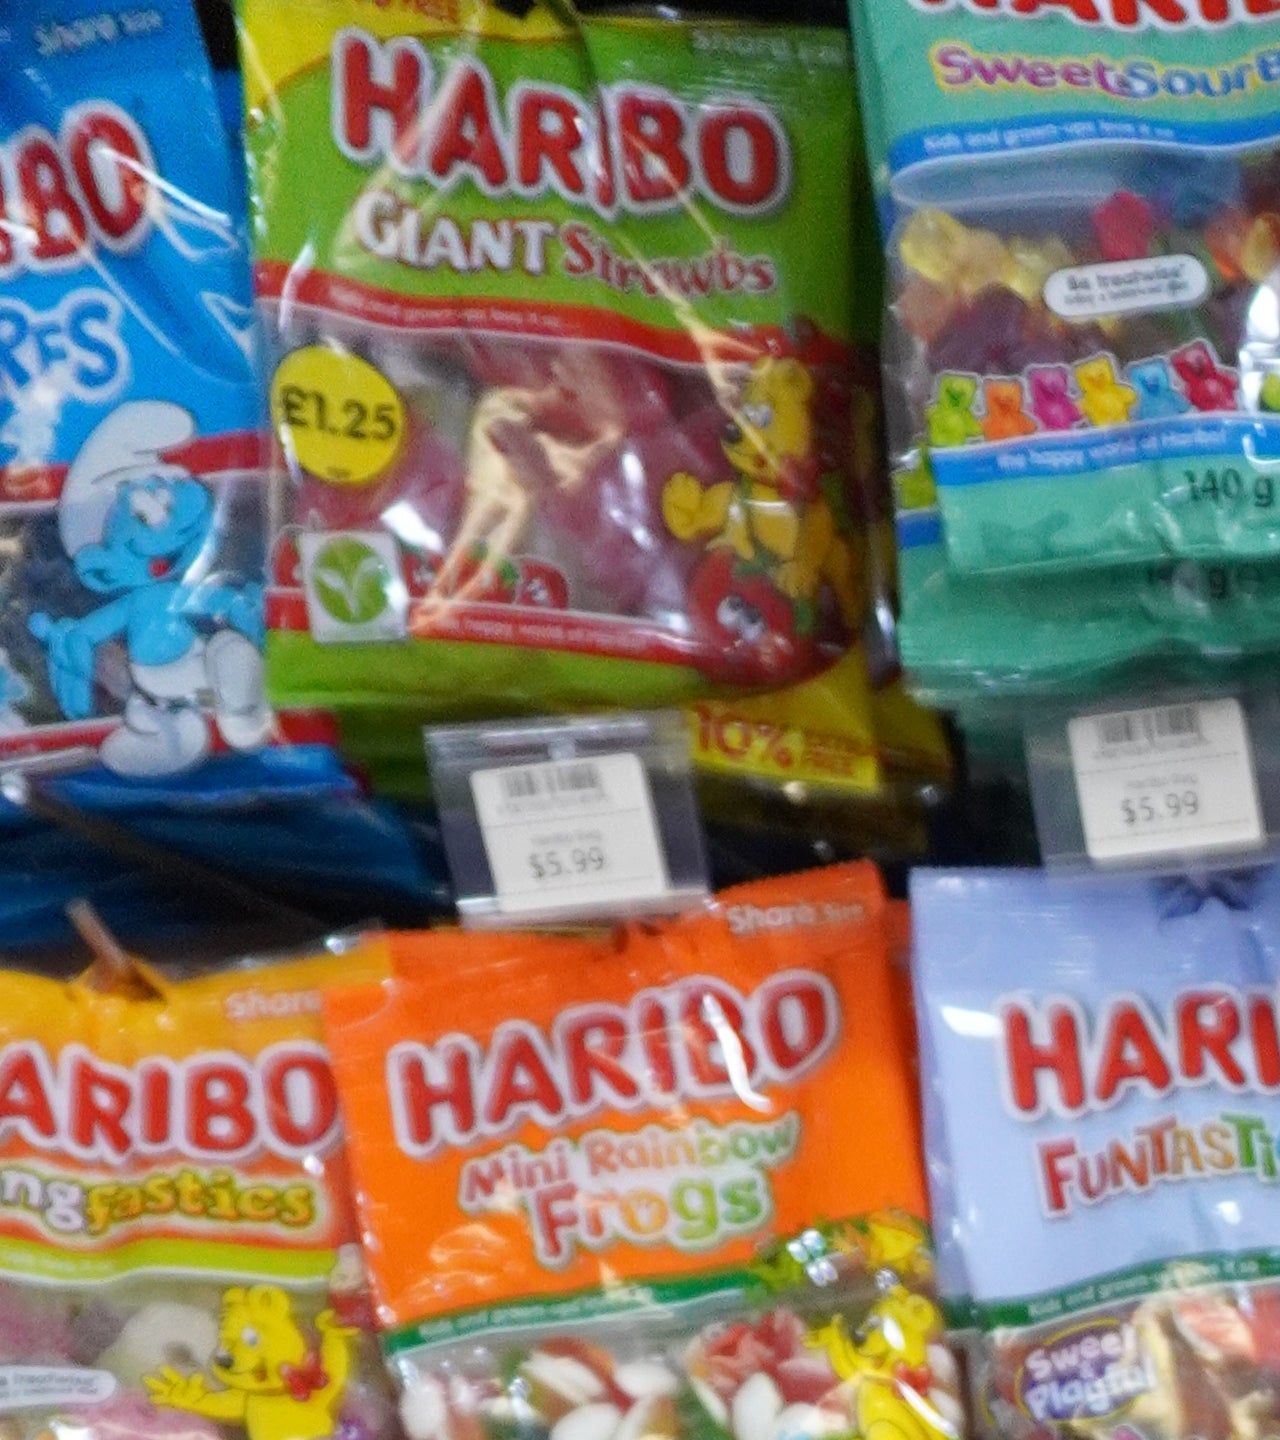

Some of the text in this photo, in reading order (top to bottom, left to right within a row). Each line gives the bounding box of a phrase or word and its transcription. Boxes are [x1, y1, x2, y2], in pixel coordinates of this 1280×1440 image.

[335, 28, 790, 218] HARIBO
[357, 188, 556, 276] GIANT
[280, 385, 396, 445] £1.25
[697, 702, 793, 768] 10%
[1121, 791, 1199, 826] $5.99
[528, 846, 605, 880] $5.99
[388, 972, 845, 1155] HARIBO
[460, 1108, 803, 1216] Mini Rainbow
[526, 1168, 773, 1272] Frogs
[1025, 1362, 1156, 1416] Playful
